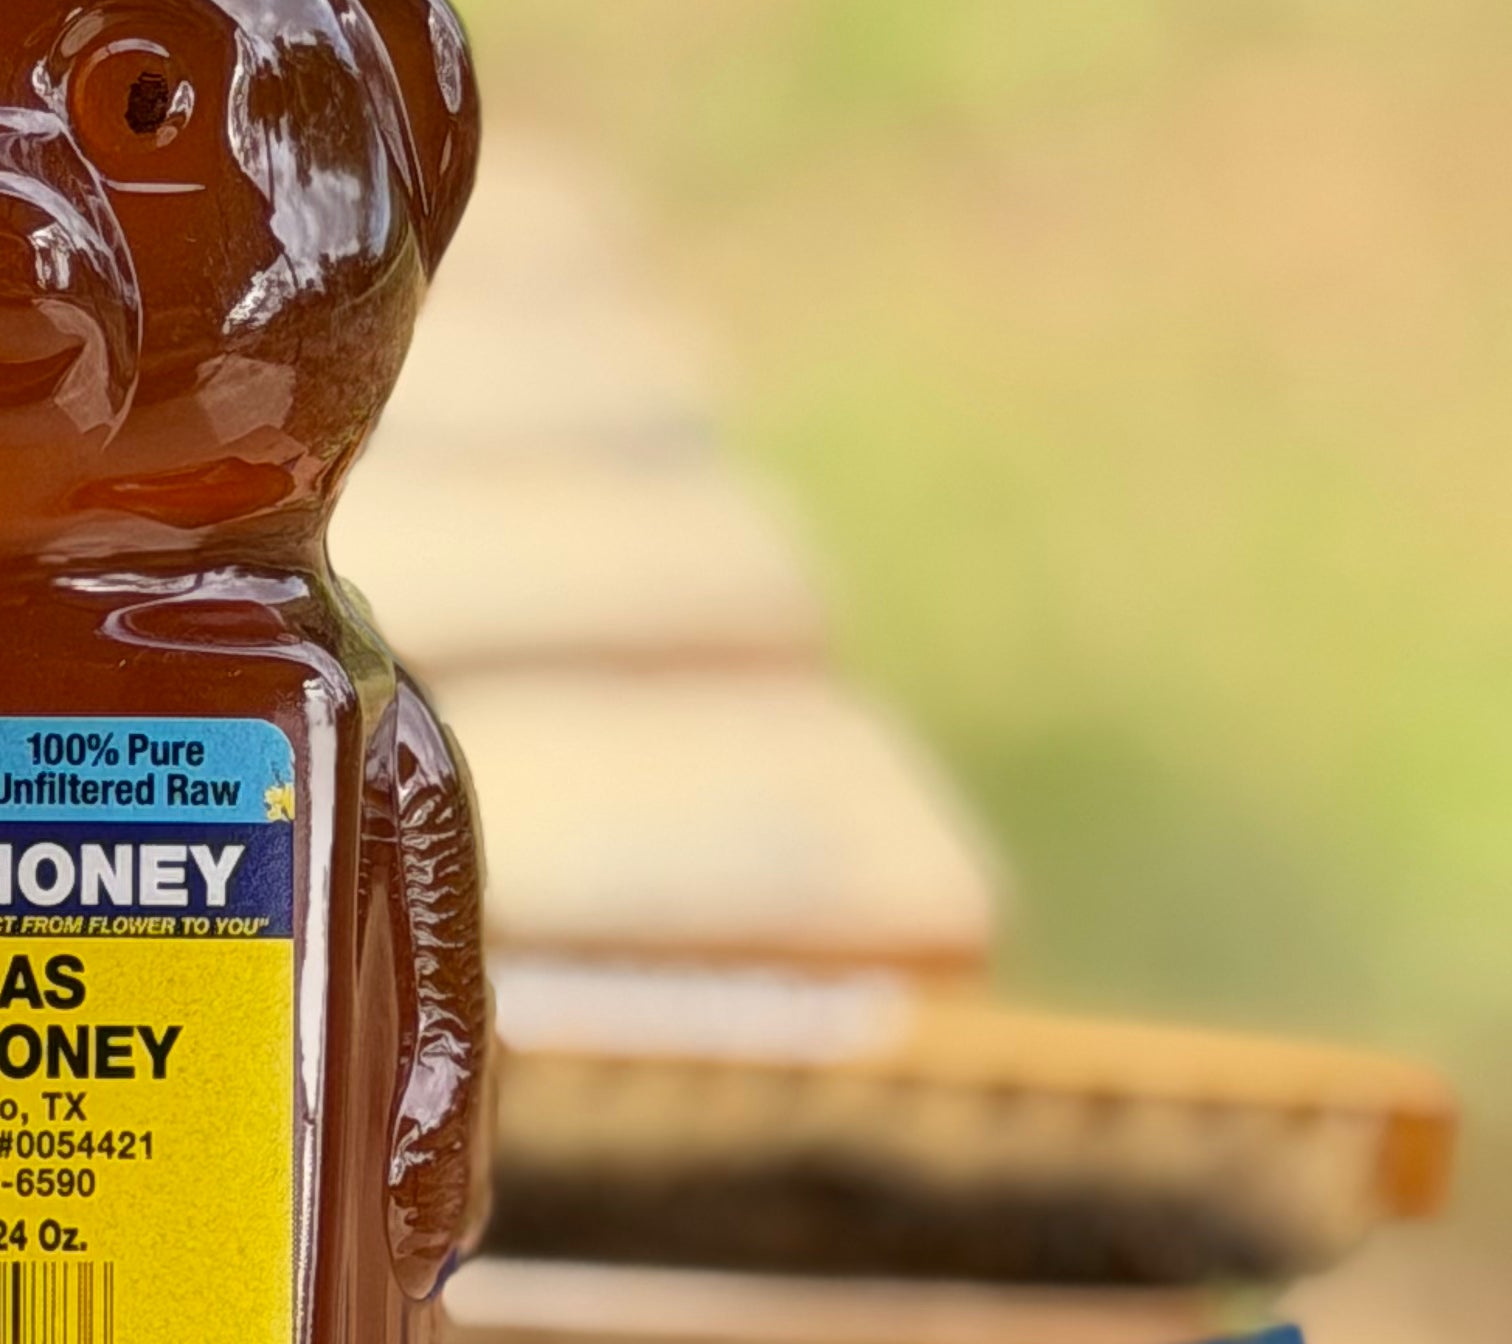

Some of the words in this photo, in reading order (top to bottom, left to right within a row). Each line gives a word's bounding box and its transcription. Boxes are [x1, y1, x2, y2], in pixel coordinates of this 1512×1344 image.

[26, 732, 120, 767] 100%
[128, 733, 205, 767] Pure
[166, 774, 241, 807] Raw
[21, 915, 85, 935] FROM
[88, 916, 177, 935] FLOWER
[180, 916, 210, 936] TO
[41, 1092, 87, 1122] TX
[38, 1219, 88, 1252] Oz.
